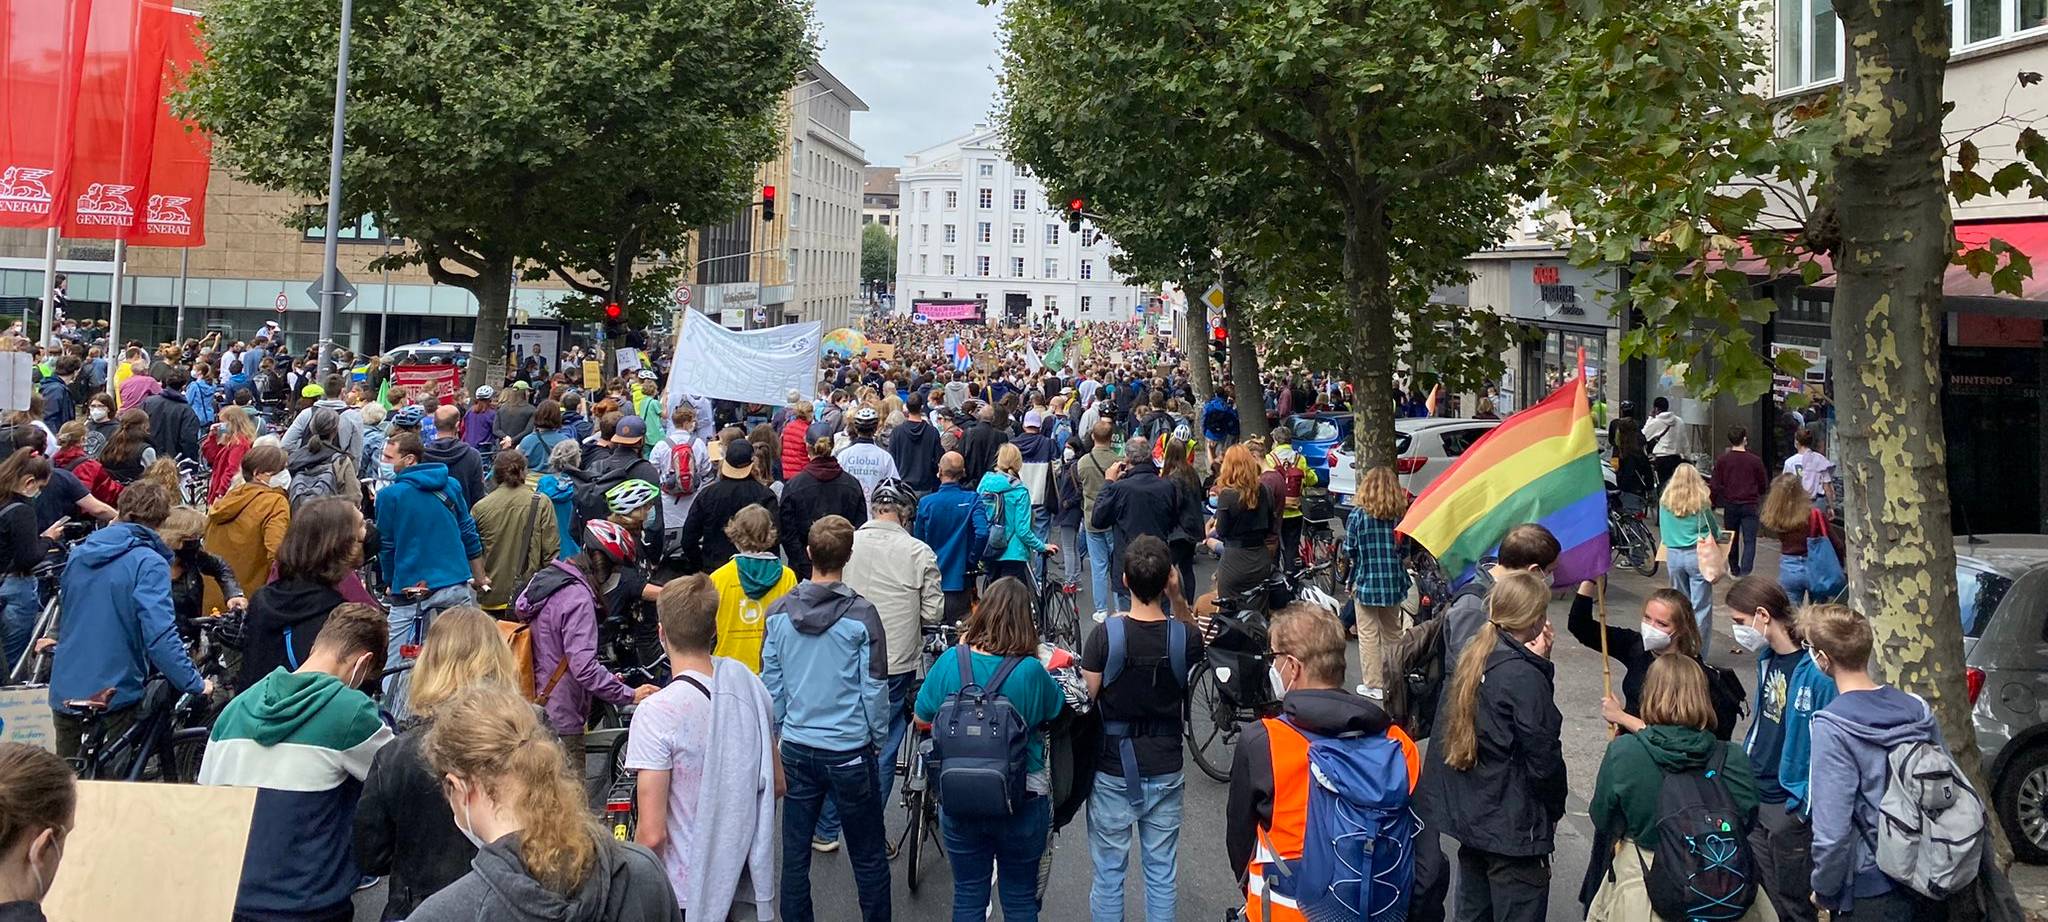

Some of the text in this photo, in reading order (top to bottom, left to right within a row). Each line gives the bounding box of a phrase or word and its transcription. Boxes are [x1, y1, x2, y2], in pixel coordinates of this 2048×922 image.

[0, 200, 50, 214] ENERALI
[76, 213, 133, 227] GENERALI
[147, 223, 191, 236] ENERALI
[678, 291, 688, 299] 30
[1951, 375, 2014, 385] NINTENDO
[847, 455, 880, 466] Global
[848, 466, 879, 477] Future
